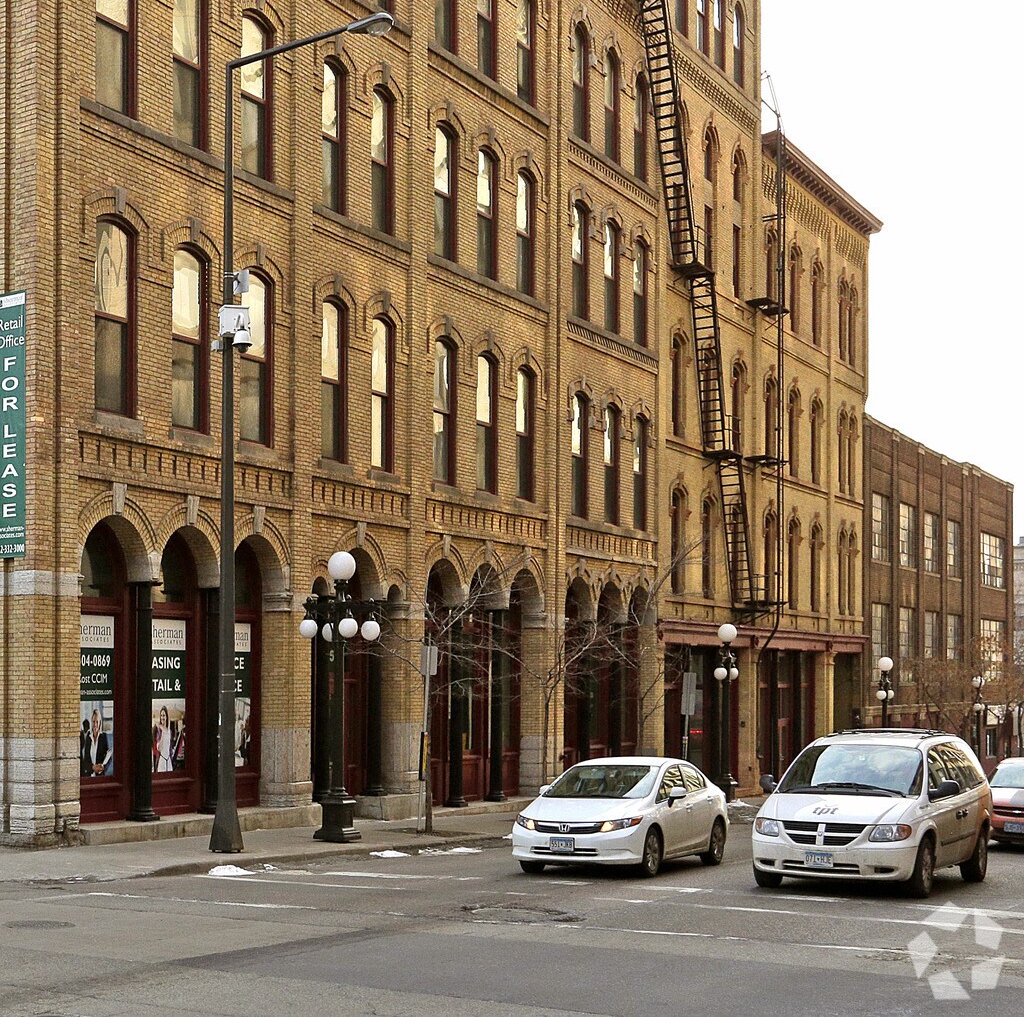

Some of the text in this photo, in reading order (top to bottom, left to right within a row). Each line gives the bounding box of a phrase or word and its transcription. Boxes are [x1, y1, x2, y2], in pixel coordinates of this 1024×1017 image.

[1, 356, 19, 412] FOR
[1, 424, 19, 518] LEASE
[152, 656, 181, 670] ASING
[91, 673, 108, 684] CCIM
[152, 678, 182, 692] TAIL &
